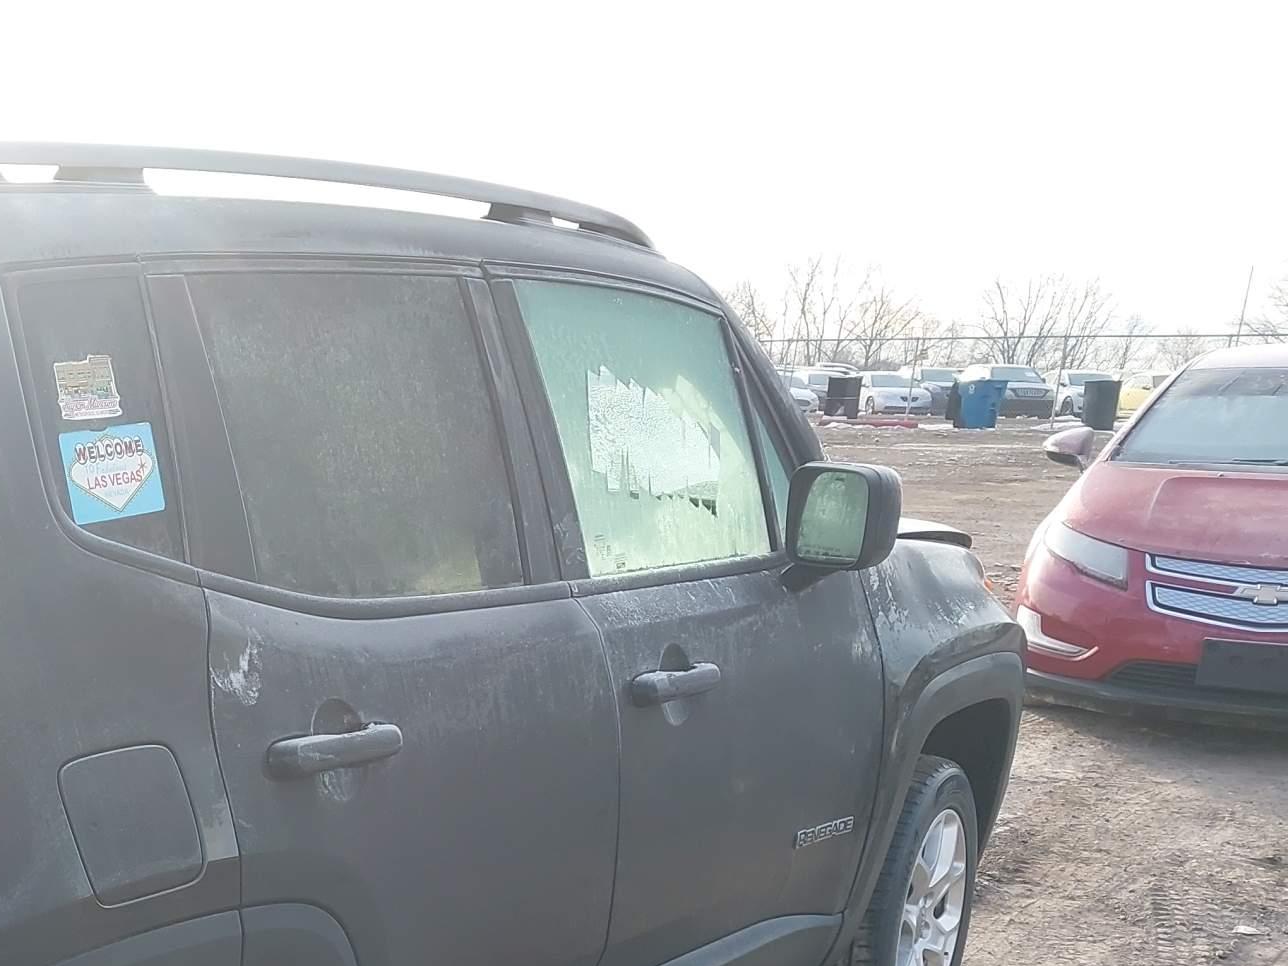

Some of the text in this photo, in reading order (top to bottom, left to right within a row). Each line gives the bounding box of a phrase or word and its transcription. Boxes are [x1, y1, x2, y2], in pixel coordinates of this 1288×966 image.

[75, 439, 142, 461] WELCOME
[87, 469, 142, 490] LAS VEGAS
[796, 816, 854, 848] RENEGADE
